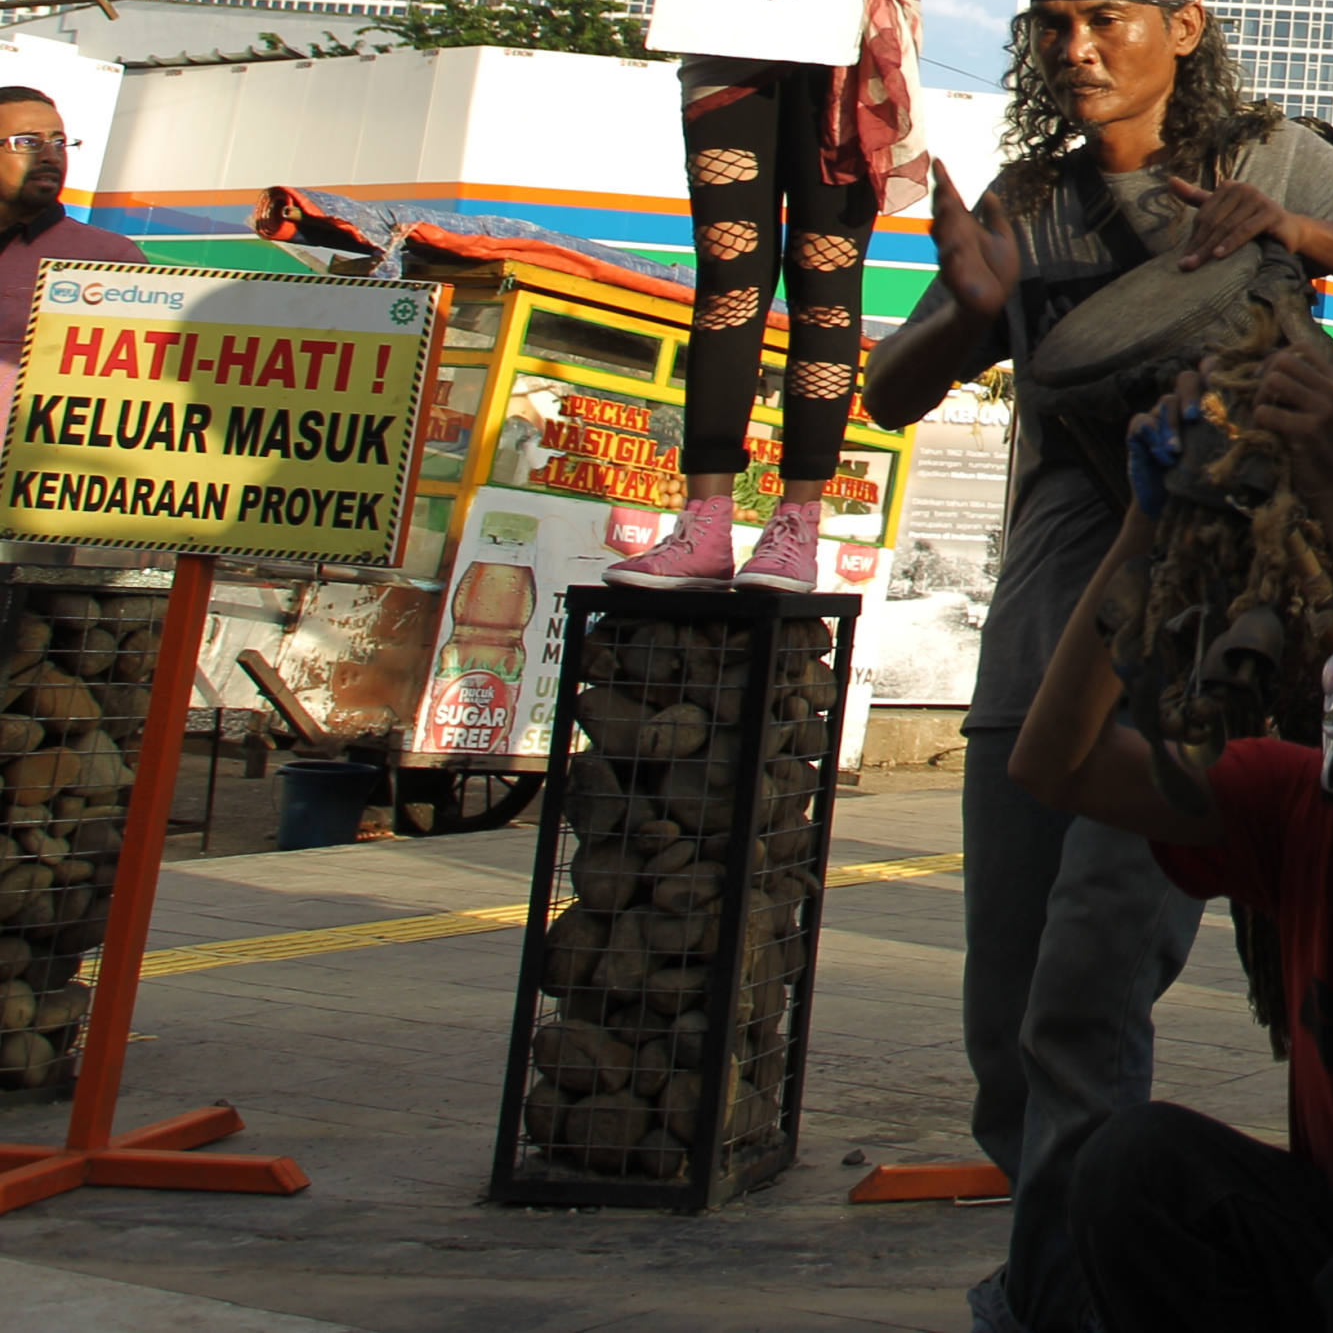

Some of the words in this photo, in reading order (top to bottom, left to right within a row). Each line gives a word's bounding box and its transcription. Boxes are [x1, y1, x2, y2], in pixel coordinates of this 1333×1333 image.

[82, 282, 184, 310] Gedung
[58, 325, 355, 393] HATI-HATI
[24, 394, 212, 454] KELUAR
[222, 405, 397, 465] MASUK
[10, 470, 230, 521] KENDARAAN
[237, 484, 384, 531] PROYEK
[613, 523, 653, 544] NEW
[840, 552, 875, 573] NEW
[458, 686, 495, 704] pucuk
[434, 704, 507, 727] SUGAR
[440, 727, 493, 749] FREE
